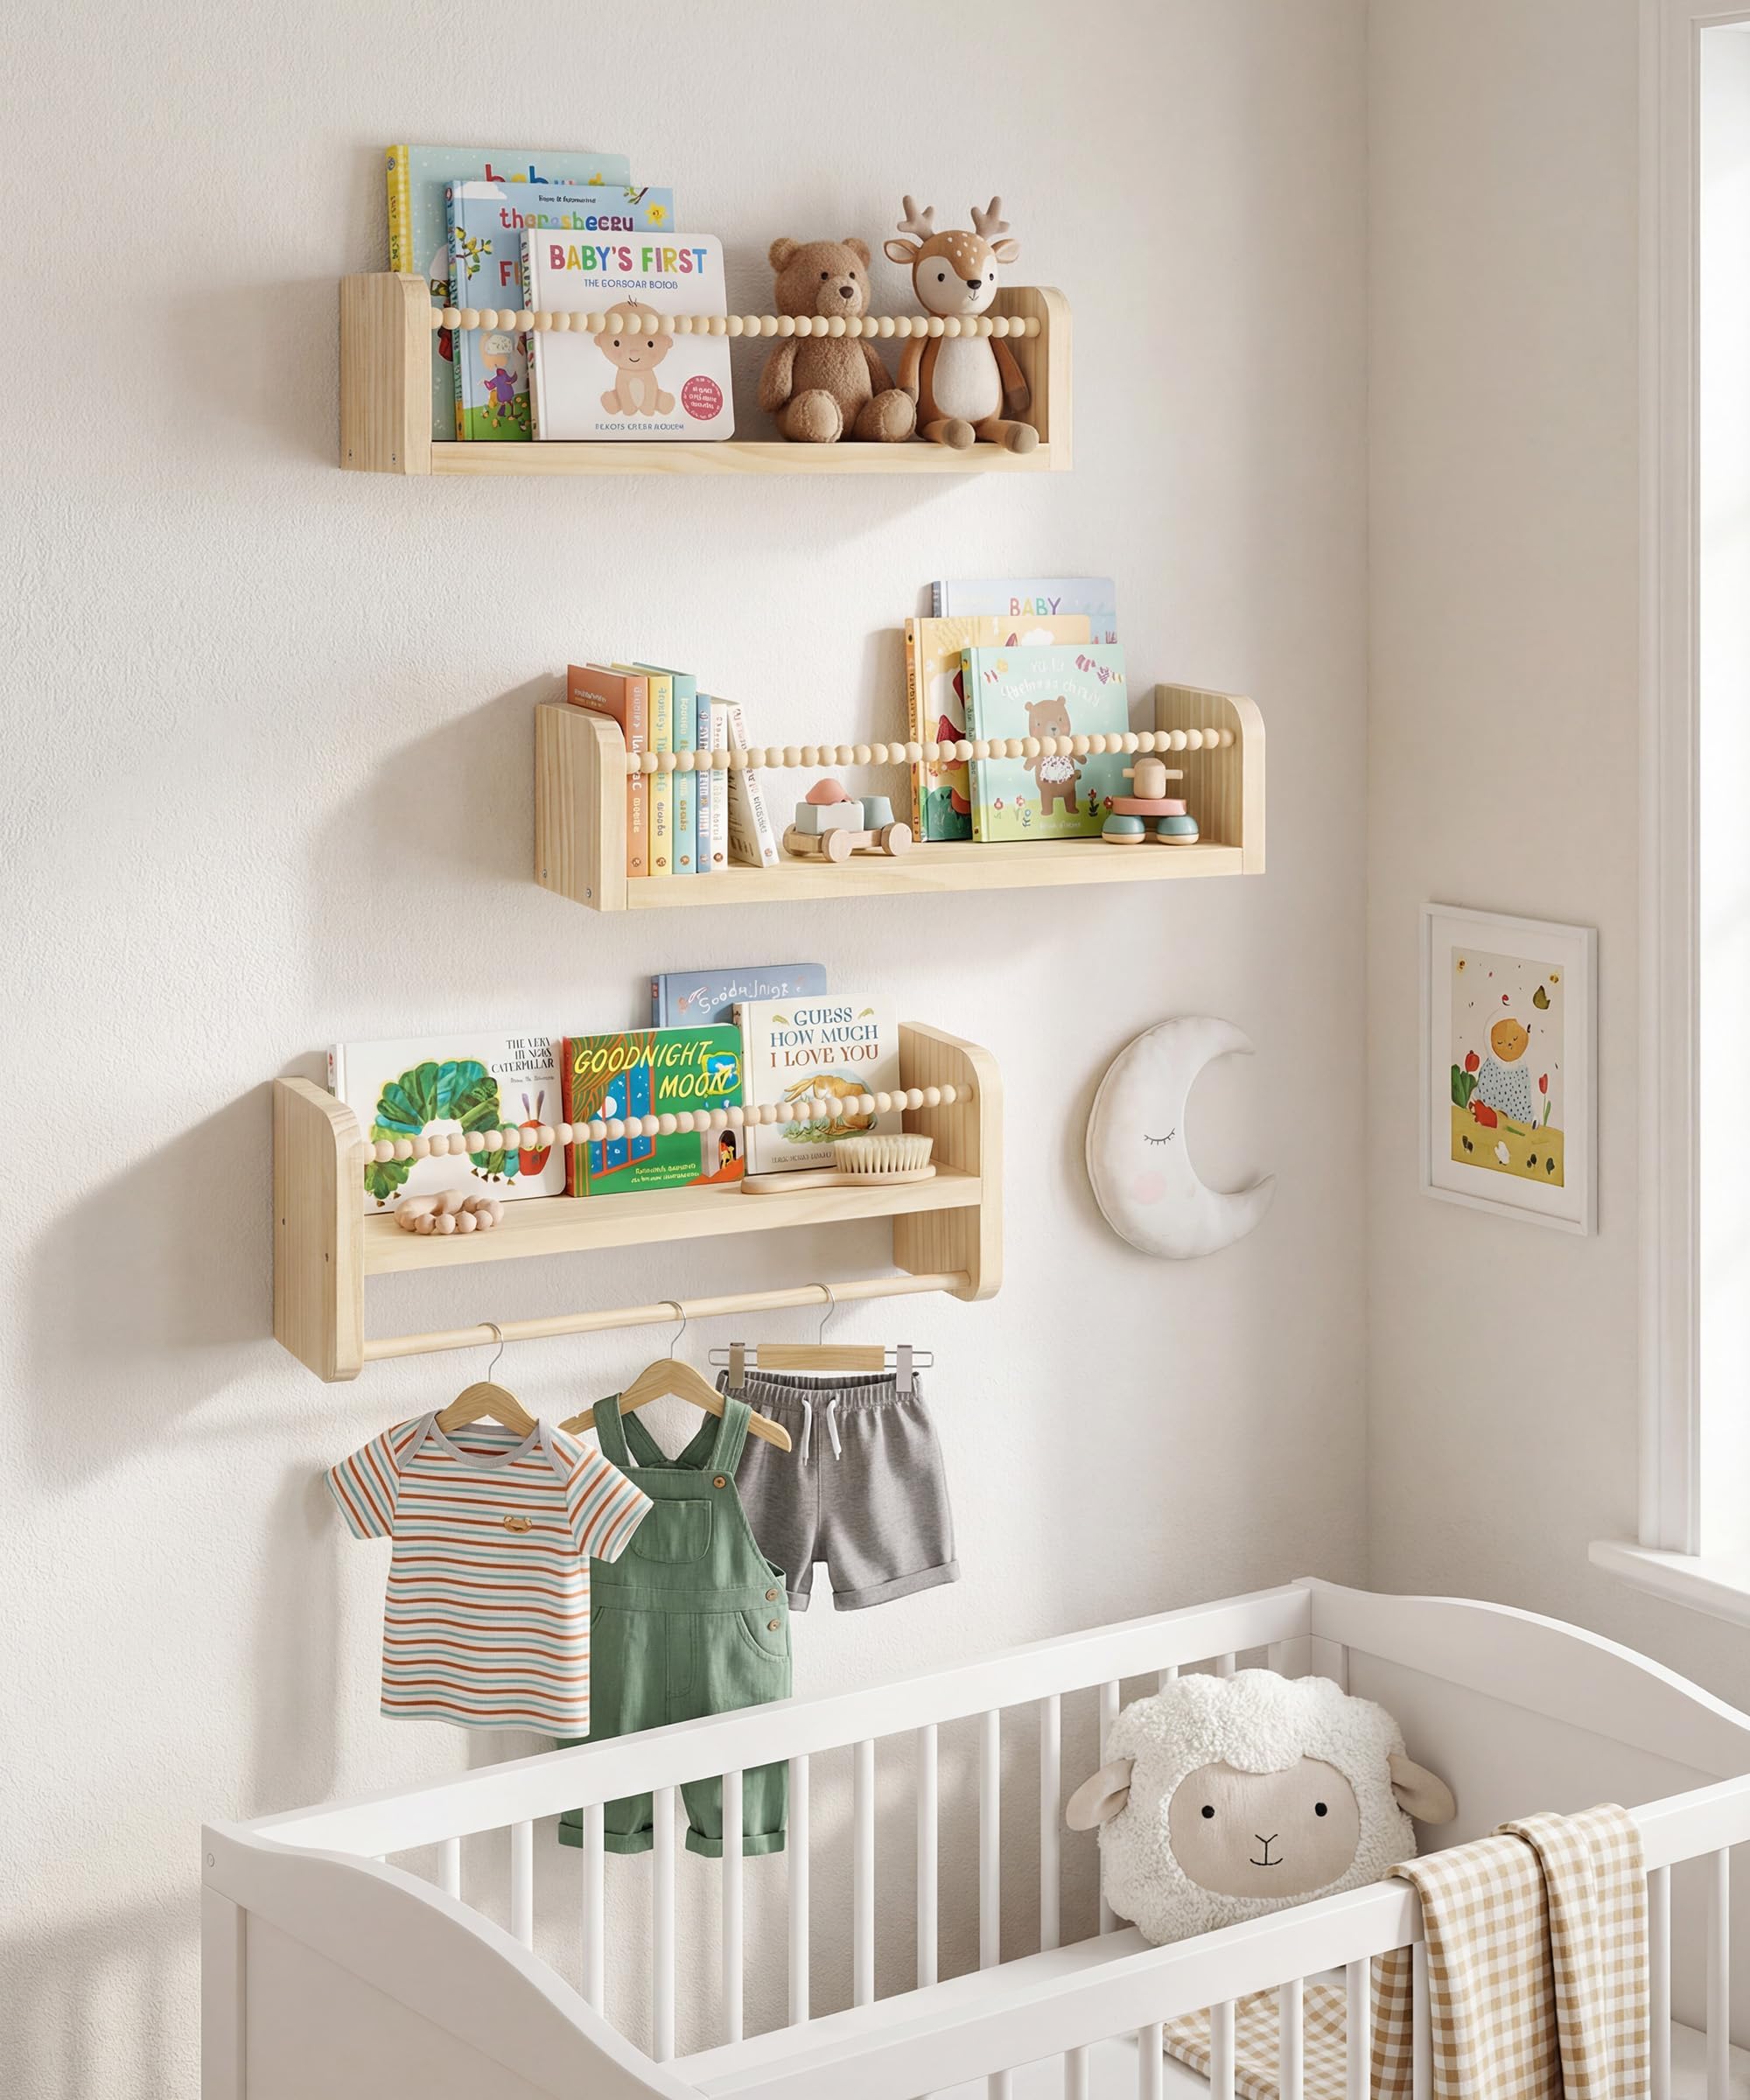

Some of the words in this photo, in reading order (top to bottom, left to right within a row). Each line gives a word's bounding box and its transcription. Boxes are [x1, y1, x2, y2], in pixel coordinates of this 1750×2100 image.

[550, 245, 633, 271] BABY'S
[641, 248, 707, 274] FIRST
[584, 279, 599, 288] THE
[1010, 598, 1061, 616] BABY
[794, 1007, 852, 1026] GUESS
[771, 1030, 814, 1047] HOW
[821, 1025, 878, 1044] MUCH
[574, 1040, 713, 1074] GOODNIGHT
[771, 1053, 777, 1068] I
[784, 1047, 835, 1067] LOVE
[840, 1045, 878, 1061] YOU
[659, 1064, 733, 1099] MOON
